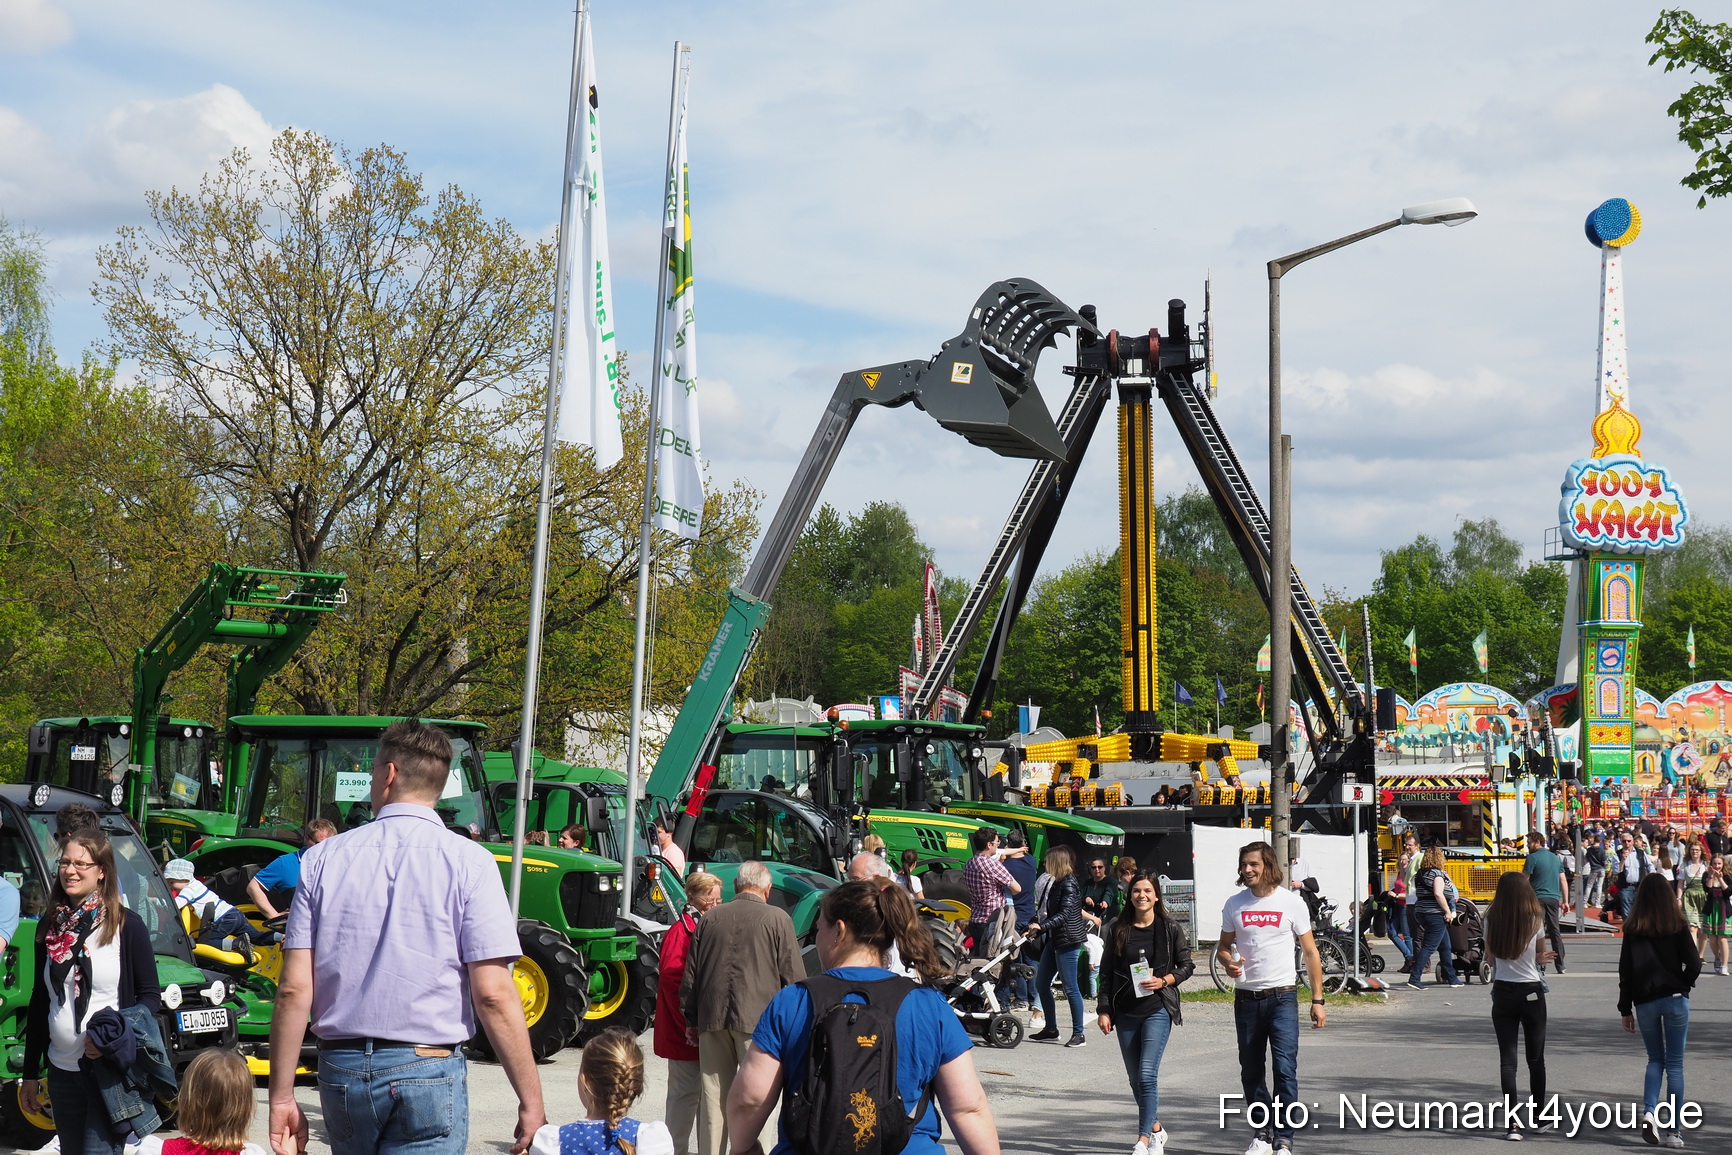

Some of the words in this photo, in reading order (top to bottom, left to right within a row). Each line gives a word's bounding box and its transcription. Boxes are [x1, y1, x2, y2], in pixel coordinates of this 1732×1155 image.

[1575, 499, 1679, 541] NACHT
[698, 621, 733, 682] KRAMER
[1400, 792, 1451, 801] CONTROLLER
[182, 1013, 194, 1029] EI
